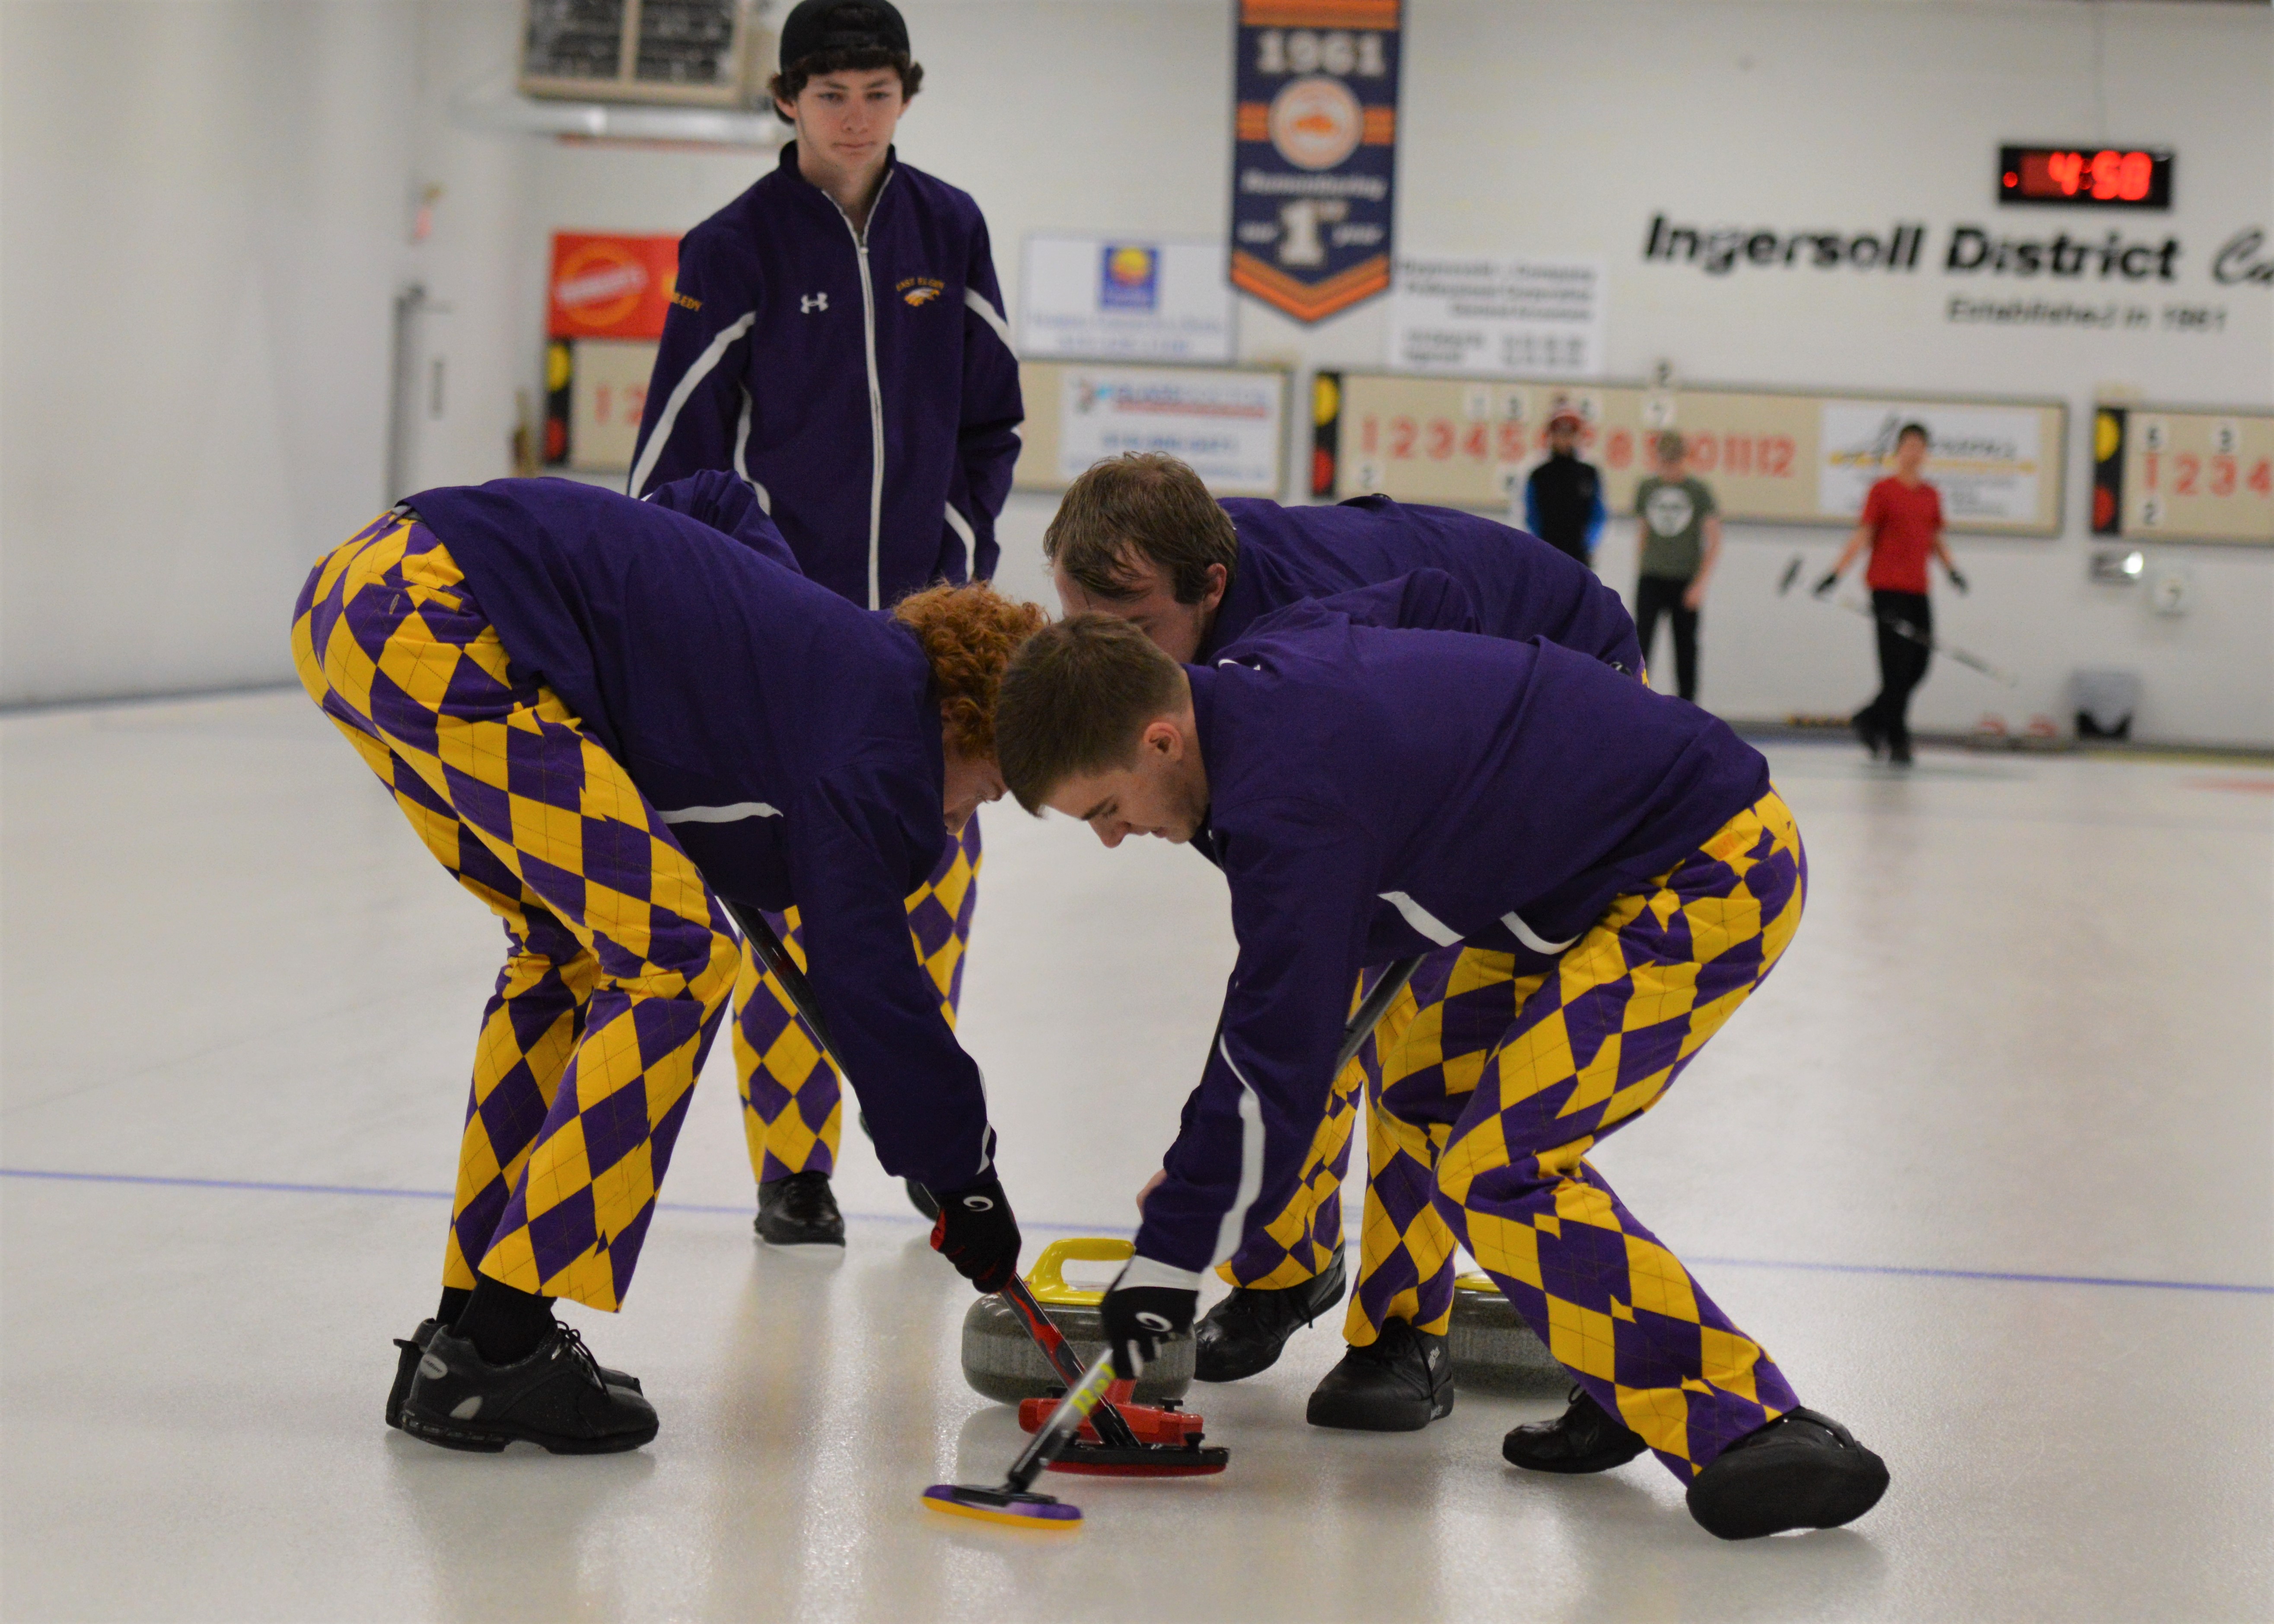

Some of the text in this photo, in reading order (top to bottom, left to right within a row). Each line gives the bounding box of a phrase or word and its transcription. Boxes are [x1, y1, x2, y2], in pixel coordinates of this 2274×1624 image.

[1258, 31, 1386, 76] 1961
[1646, 213, 1923, 275] Ingersoll
[1945, 227, 2178, 281] District
[1362, 414, 1379, 456] 1
[1389, 415, 1419, 460] 2
[1427, 416, 1456, 461] 3
[1463, 420, 1488, 461] 4
[1497, 420, 1527, 464] 5
[1757, 434, 1797, 478] 12
[2146, 451, 2273, 499] 1 2 3 4
